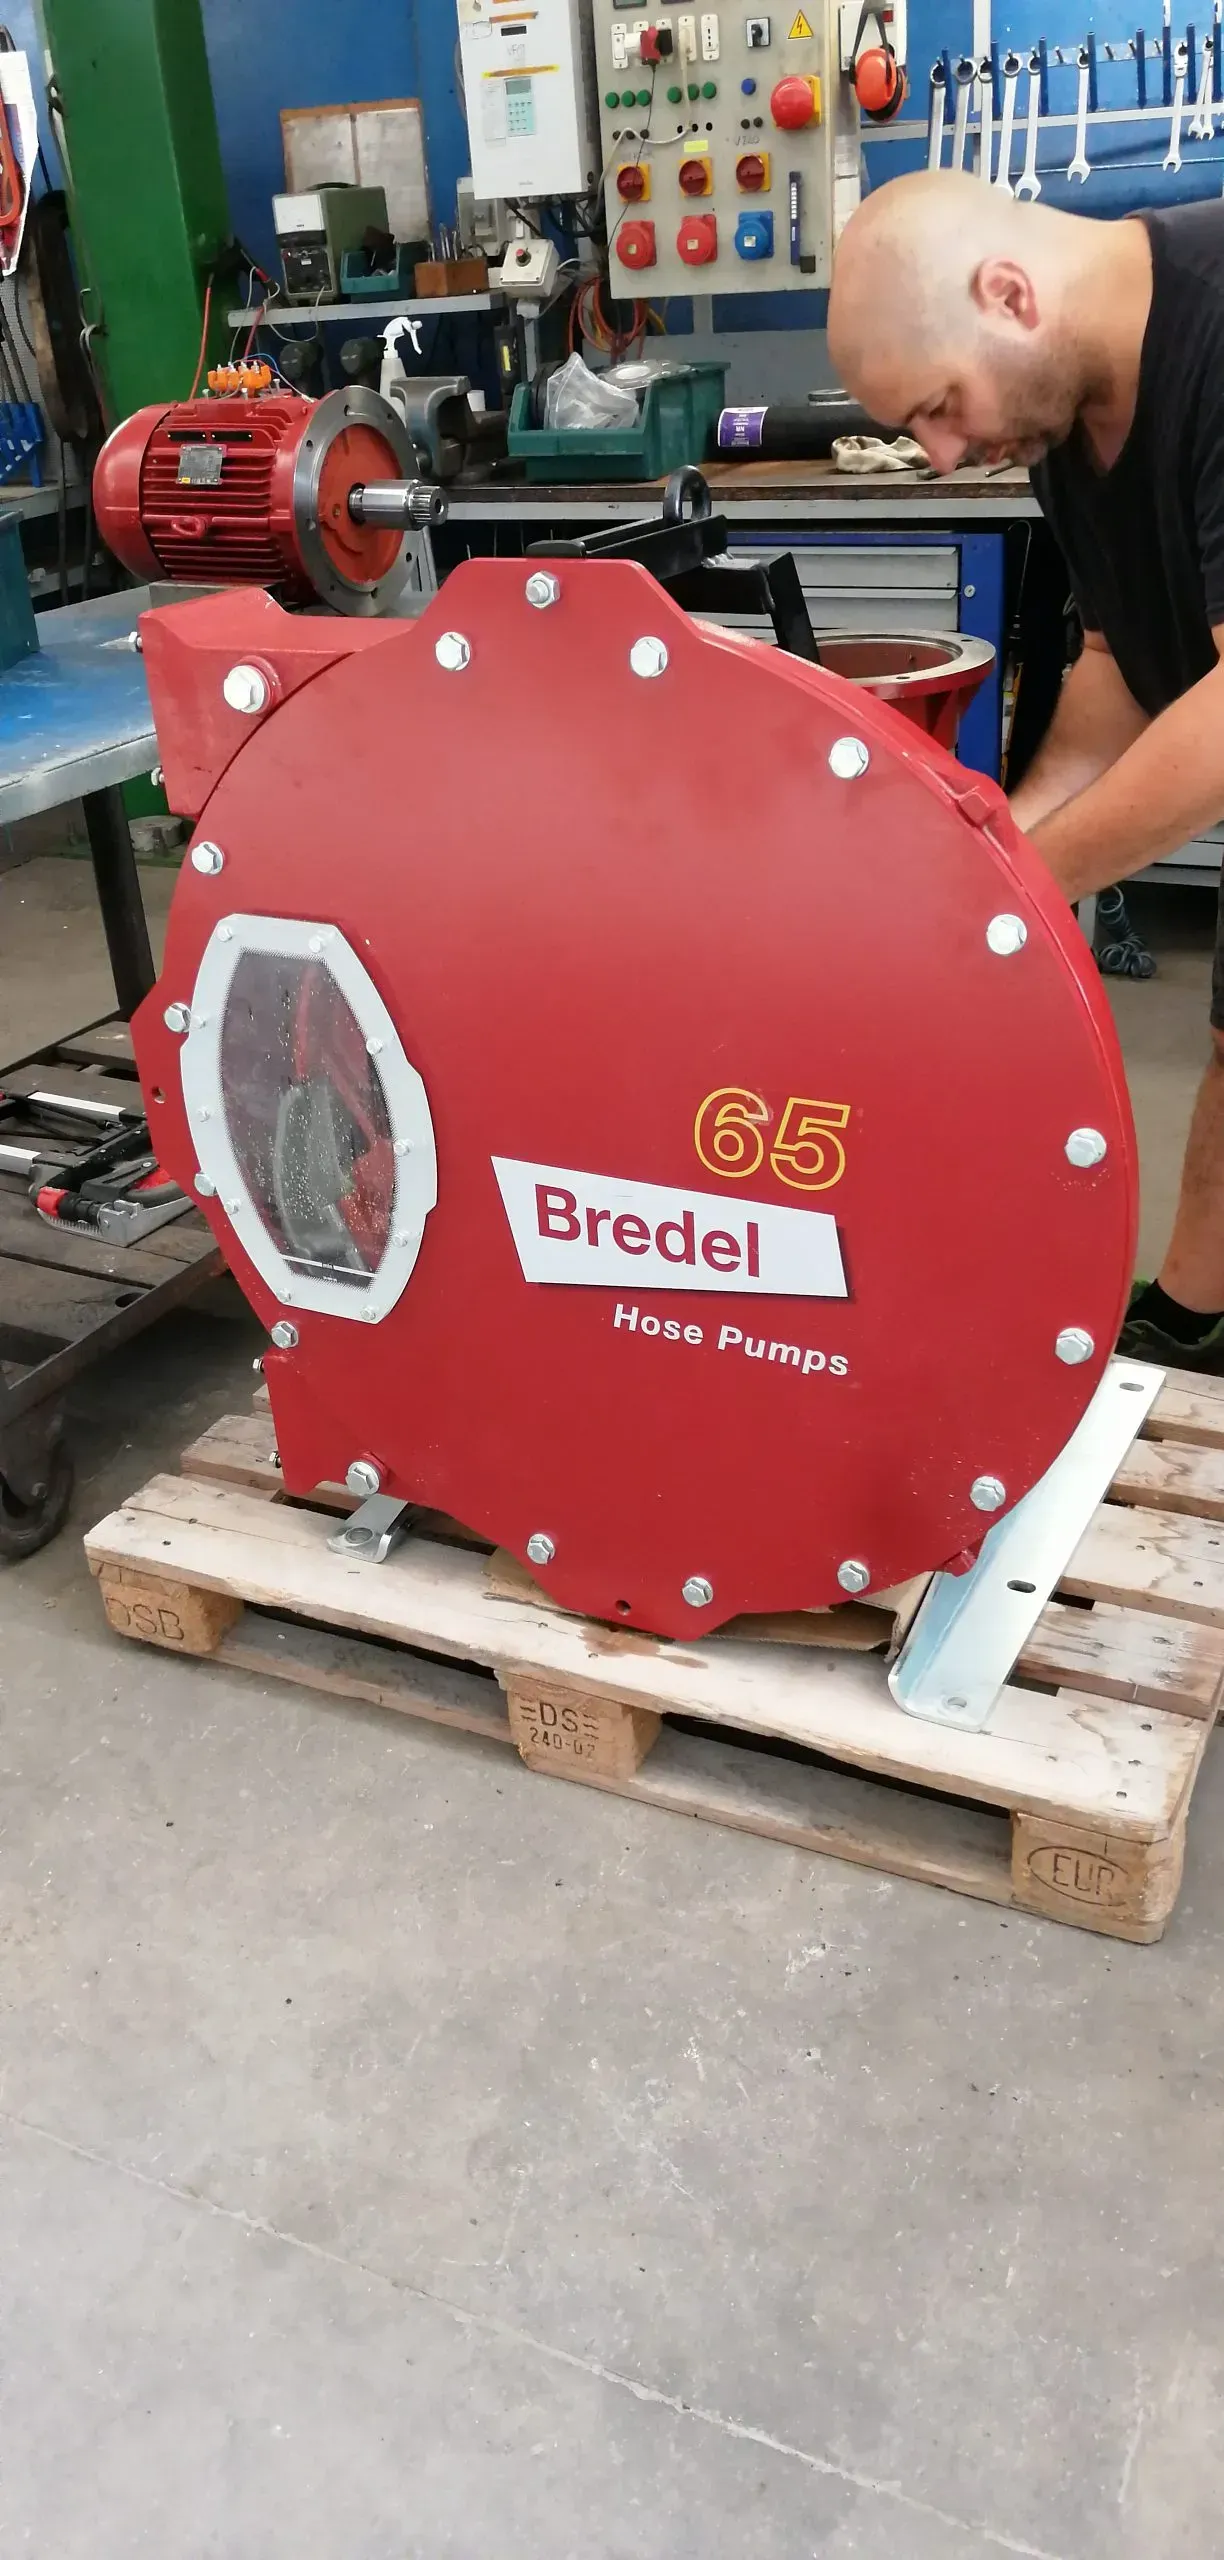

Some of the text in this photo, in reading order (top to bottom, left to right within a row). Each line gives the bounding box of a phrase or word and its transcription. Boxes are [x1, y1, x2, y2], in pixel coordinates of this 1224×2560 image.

[694, 1087, 851, 1190] 65
[534, 1183, 760, 1278] Bredel
[613, 1303, 850, 1376] Hose Pumps
[1052, 1853, 1115, 1900] EUR
